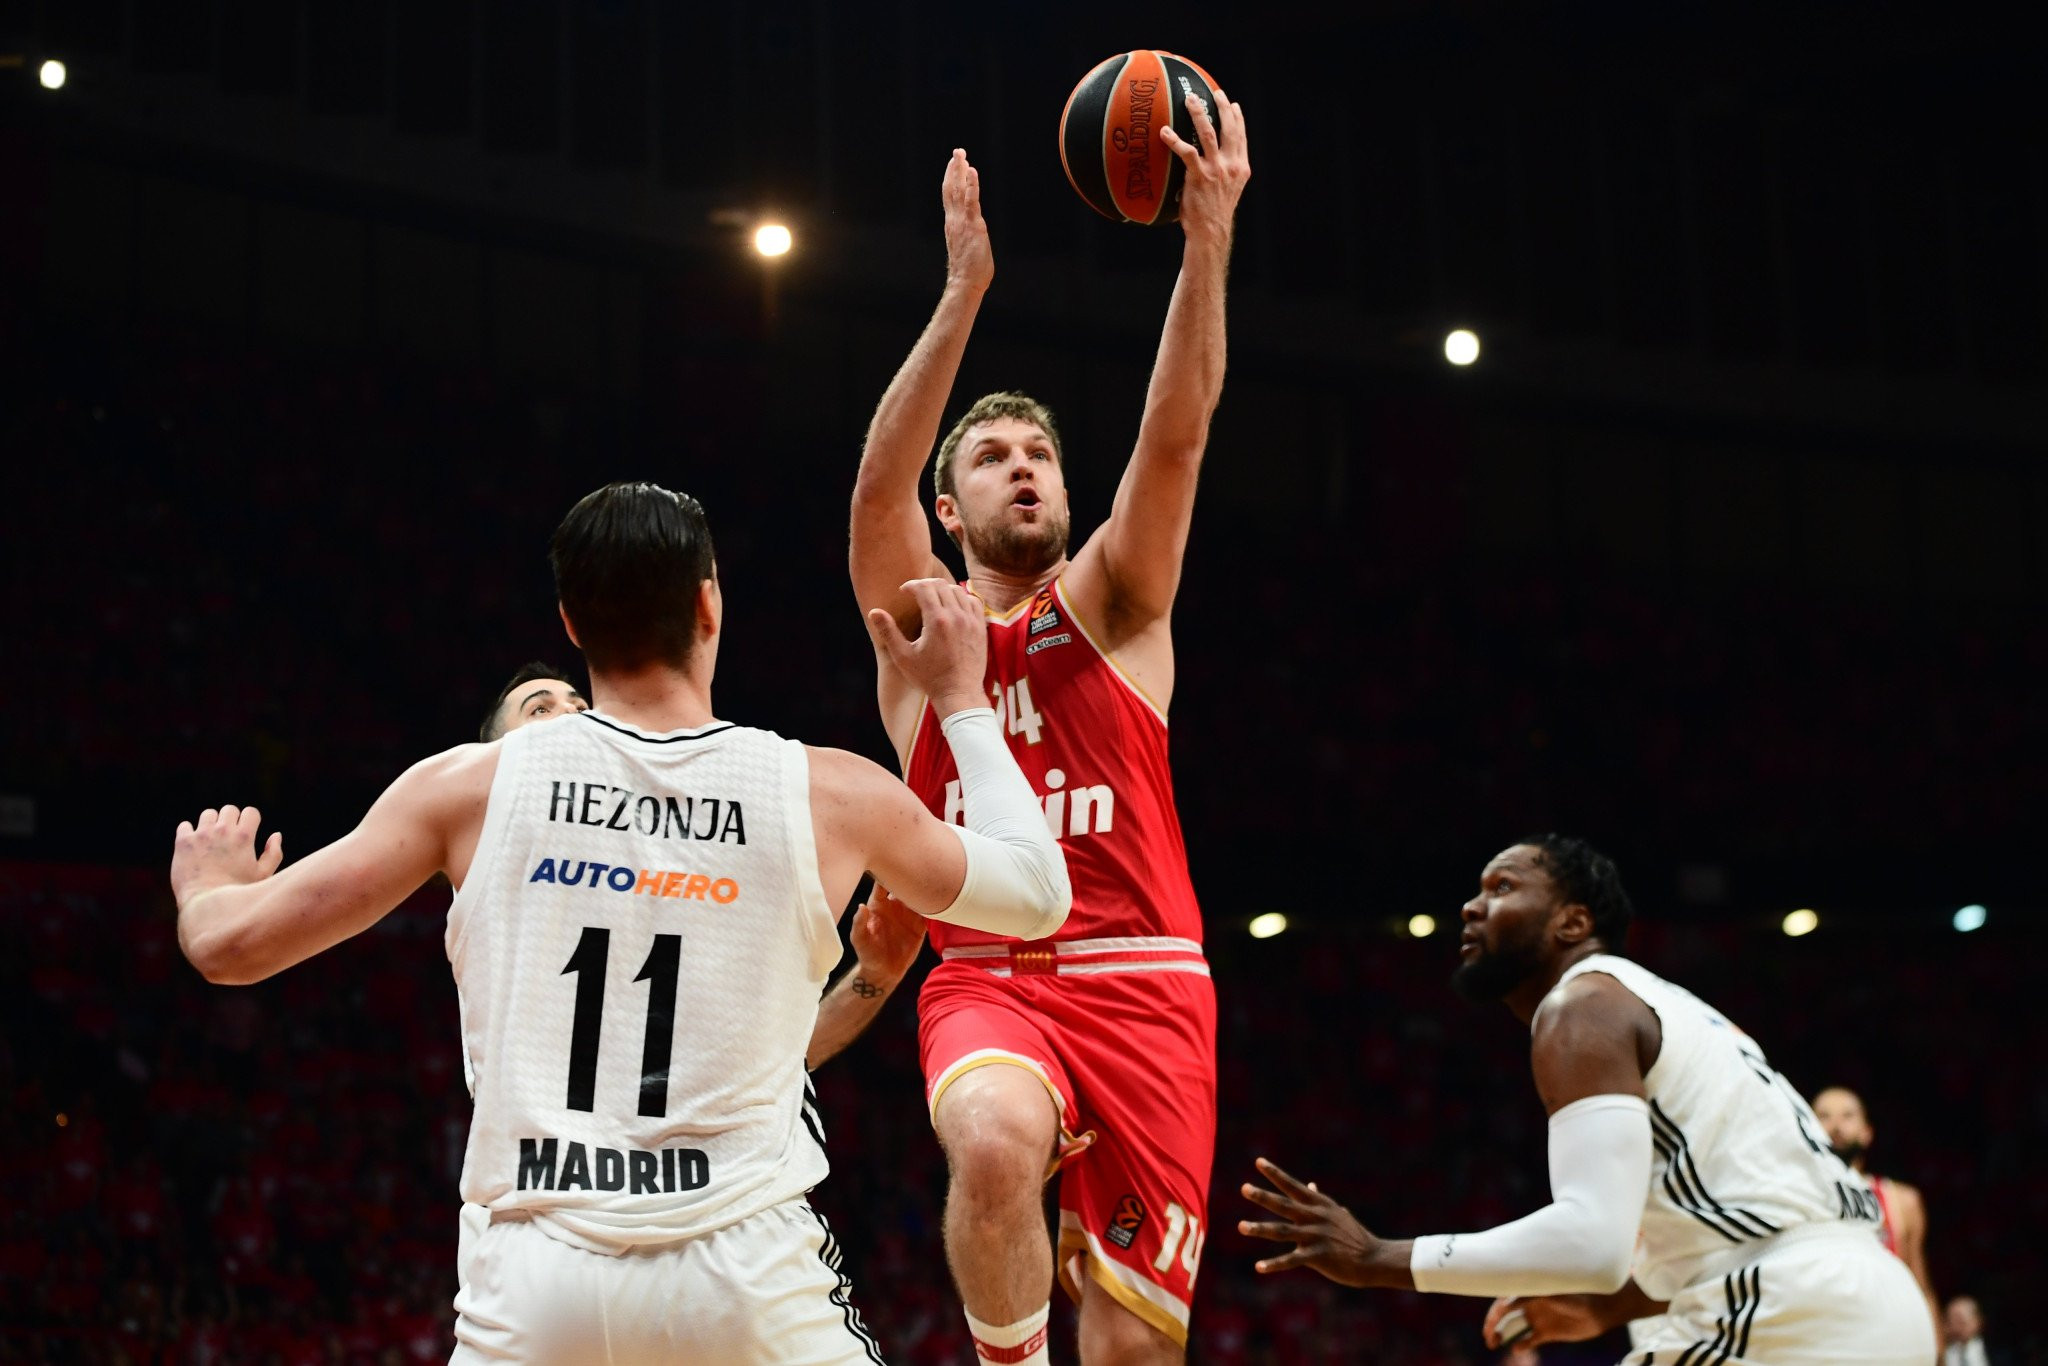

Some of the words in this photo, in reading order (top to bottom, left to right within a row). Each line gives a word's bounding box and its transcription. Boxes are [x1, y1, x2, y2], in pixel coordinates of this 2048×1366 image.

[1126, 78, 1159, 200] SPALDING
[1027, 635, 1070, 653] oneteam
[548, 780, 747, 846] HEZONJA
[944, 768, 1115, 840] in
[530, 858, 739, 904] AUTOHERO
[560, 926, 682, 1119] 11
[517, 1138, 710, 1195] MADRID
